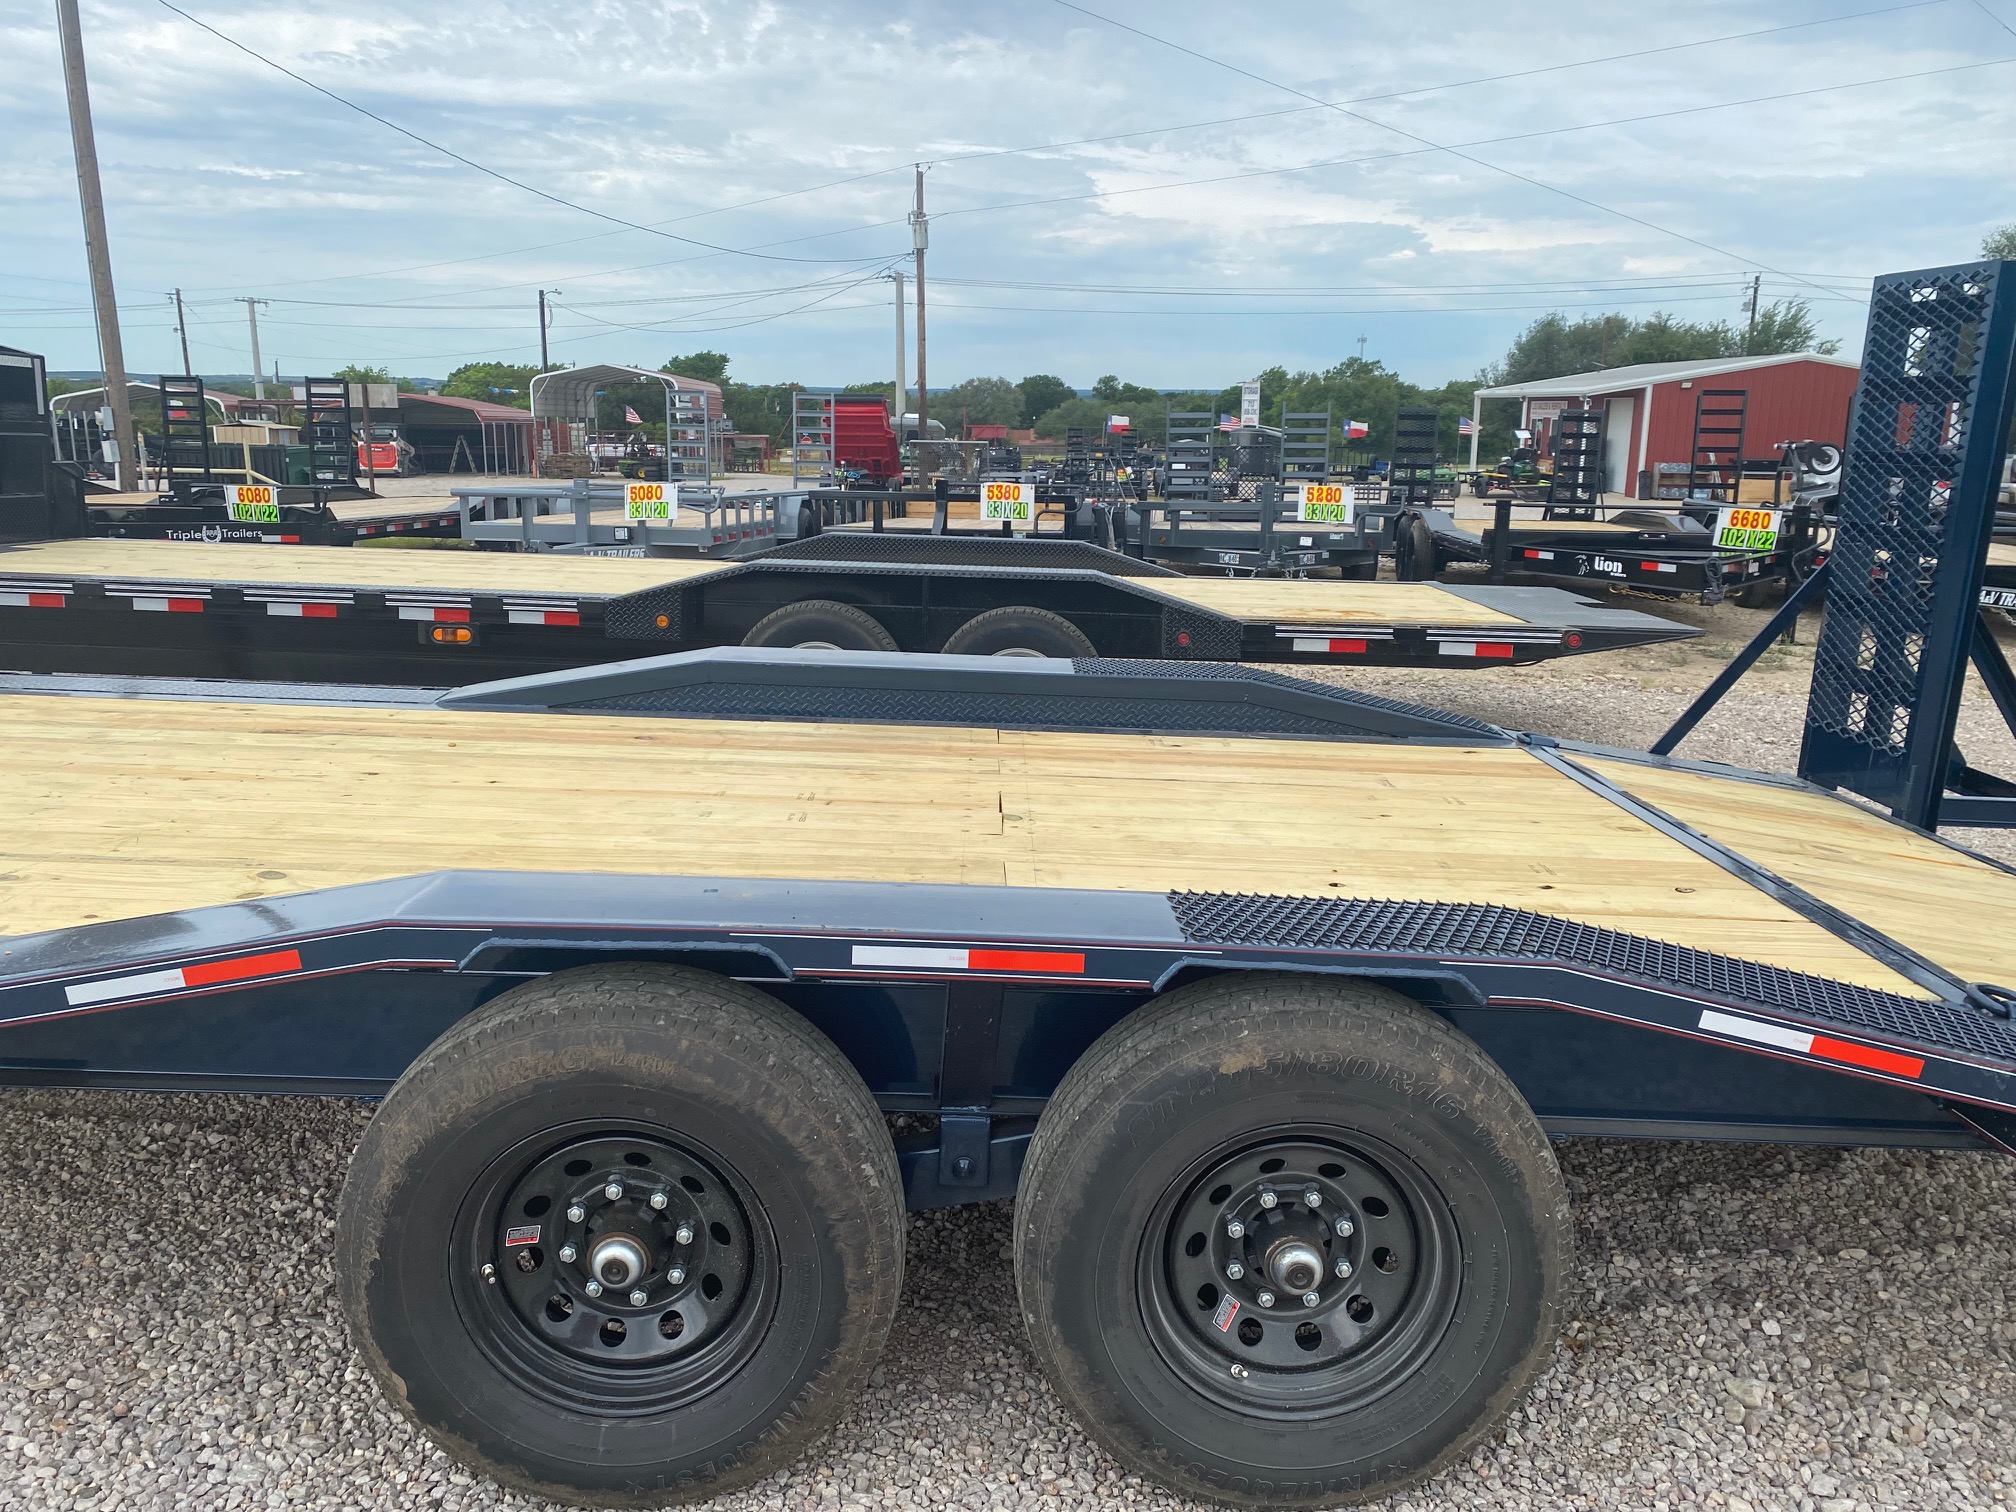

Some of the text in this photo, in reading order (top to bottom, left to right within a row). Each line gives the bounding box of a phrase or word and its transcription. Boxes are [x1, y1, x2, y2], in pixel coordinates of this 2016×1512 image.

[237, 487, 271, 503] 6080
[630, 485, 663, 501] 5080
[987, 485, 1020, 501] 5380
[1306, 487, 1342, 503] 5280
[1730, 509, 1772, 529] 6680
[166, 530, 202, 541] Triple
[222, 529, 263, 539] Trailers
[1594, 556, 1623, 573] lion
